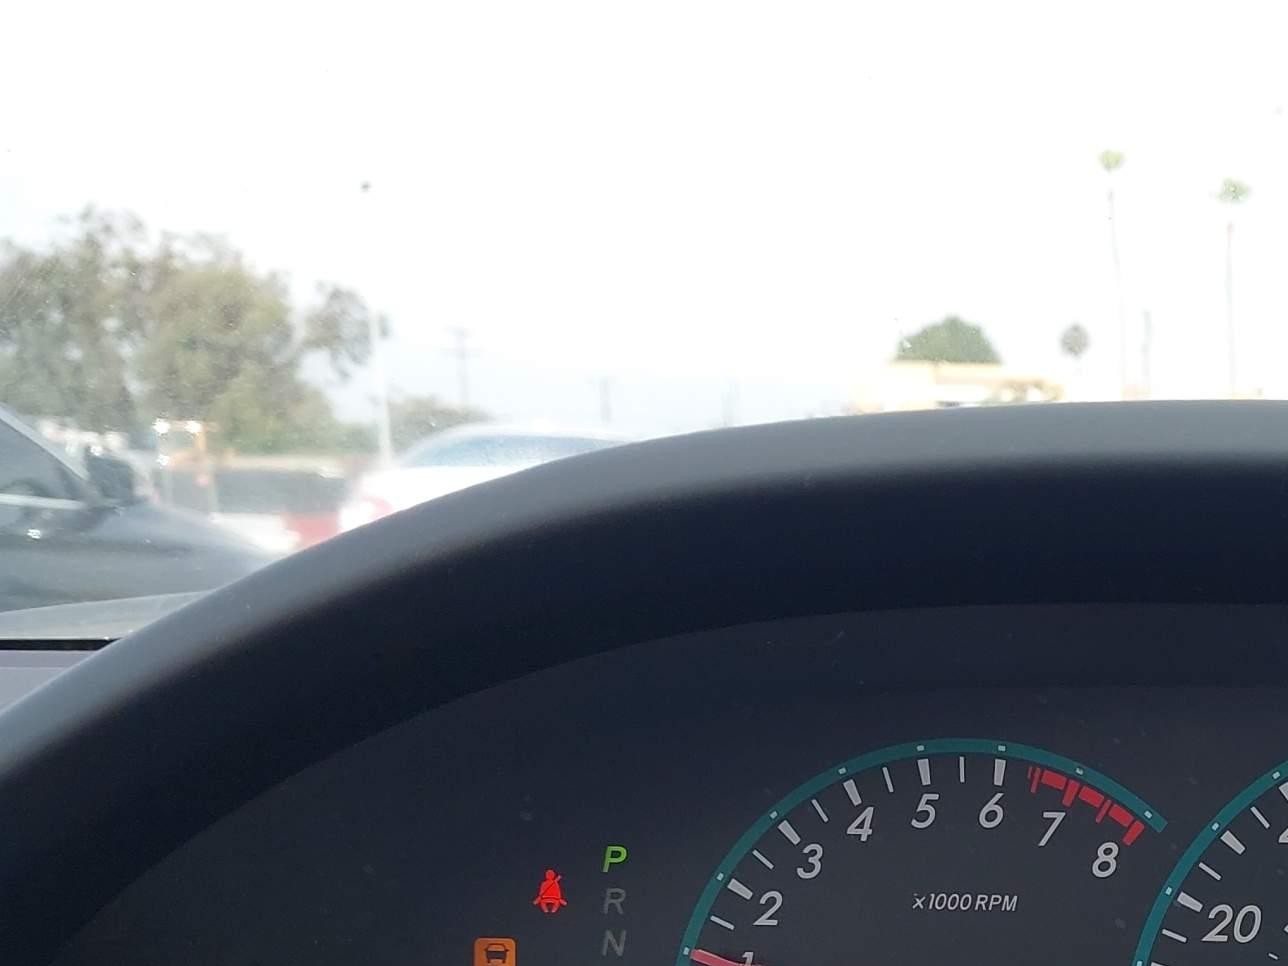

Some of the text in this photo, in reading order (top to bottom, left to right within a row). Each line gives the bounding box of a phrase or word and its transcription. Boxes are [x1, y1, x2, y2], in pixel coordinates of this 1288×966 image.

[846, 807, 875, 842] 4
[911, 793, 940, 829] 5
[979, 793, 1004, 829] 6
[1037, 811, 1066, 847] 7
[603, 846, 627, 872] P
[797, 843, 823, 879] 3
[1092, 842, 1119, 878] 8
[603, 888, 626, 914] R
[753, 891, 783, 926] 2
[975, 895, 1018, 912] RPM
[1202, 905, 1261, 944] 20
[602, 930, 626, 956] N
